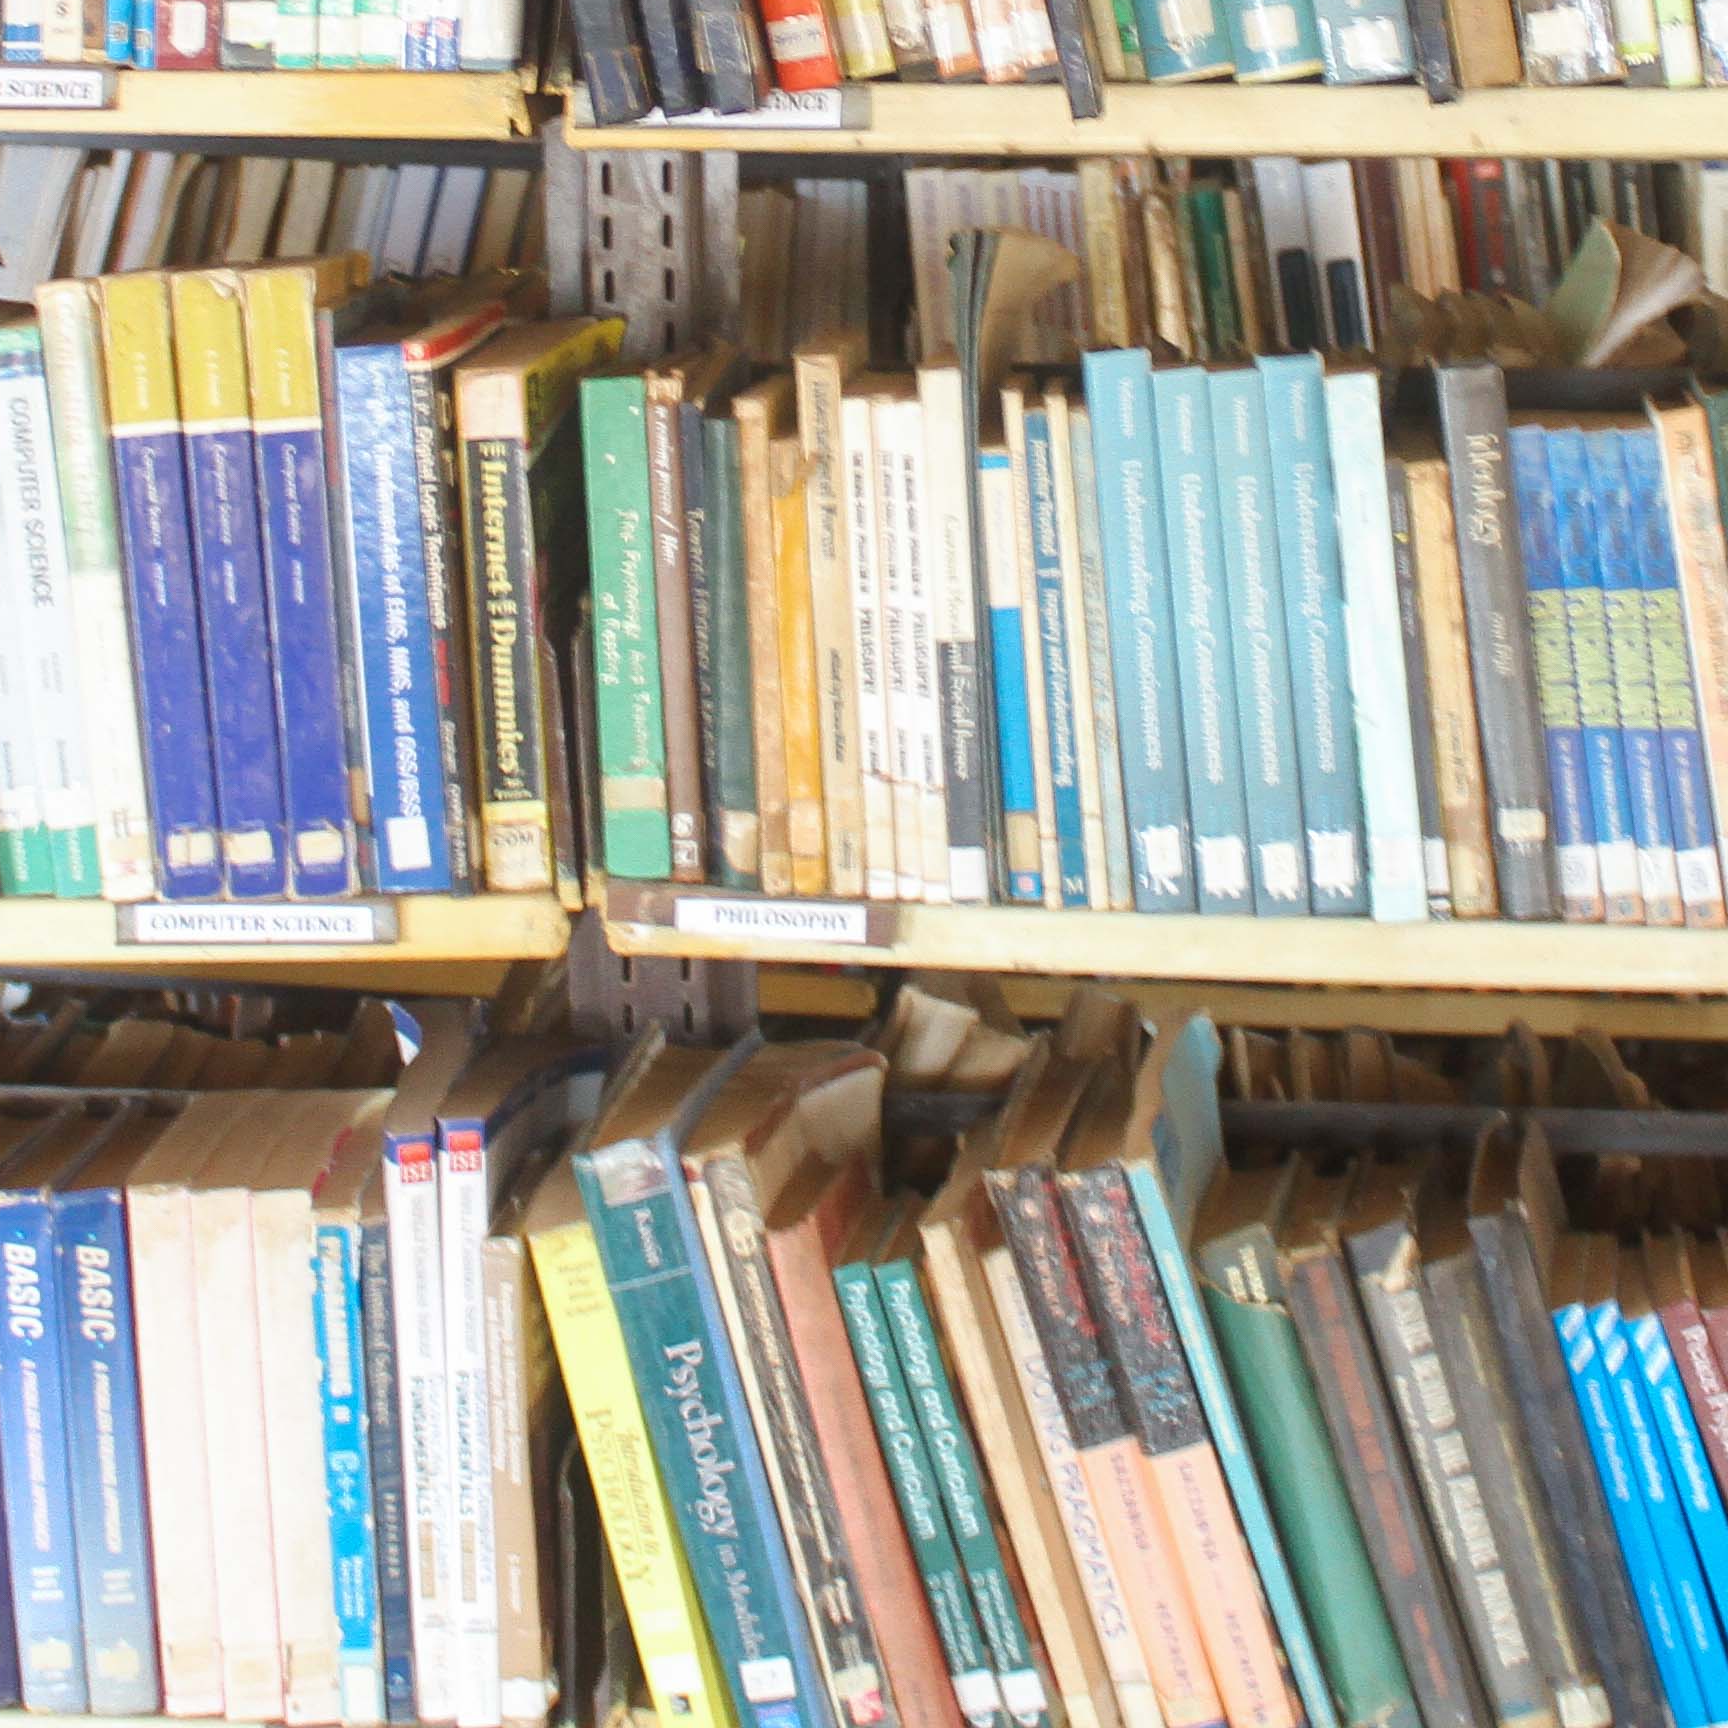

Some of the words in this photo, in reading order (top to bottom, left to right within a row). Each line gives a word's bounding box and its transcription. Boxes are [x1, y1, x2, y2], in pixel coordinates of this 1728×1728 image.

[8, 79, 92, 100] SCIENCE
[4, 395, 44, 511] COMPUTER
[365, 441, 408, 573] Fundamentals
[413, 426, 438, 479] Digital
[22, 517, 57, 609] SCIENCE
[474, 459, 517, 595] Internet
[1114, 458, 1158, 616] Understanding
[1172, 471, 1216, 630] Understanding
[1230, 474, 1274, 632] Understanding
[485, 616, 526, 773] Dummies
[151, 914, 264, 932] COMPUTER
[273, 914, 357, 933] SCIENCE
[714, 905, 849, 931] PHILOSOPHY
[3, 1241, 42, 1340] BASIC
[76, 1243, 115, 1341] BASIC
[654, 1337, 751, 1546] Psychology
